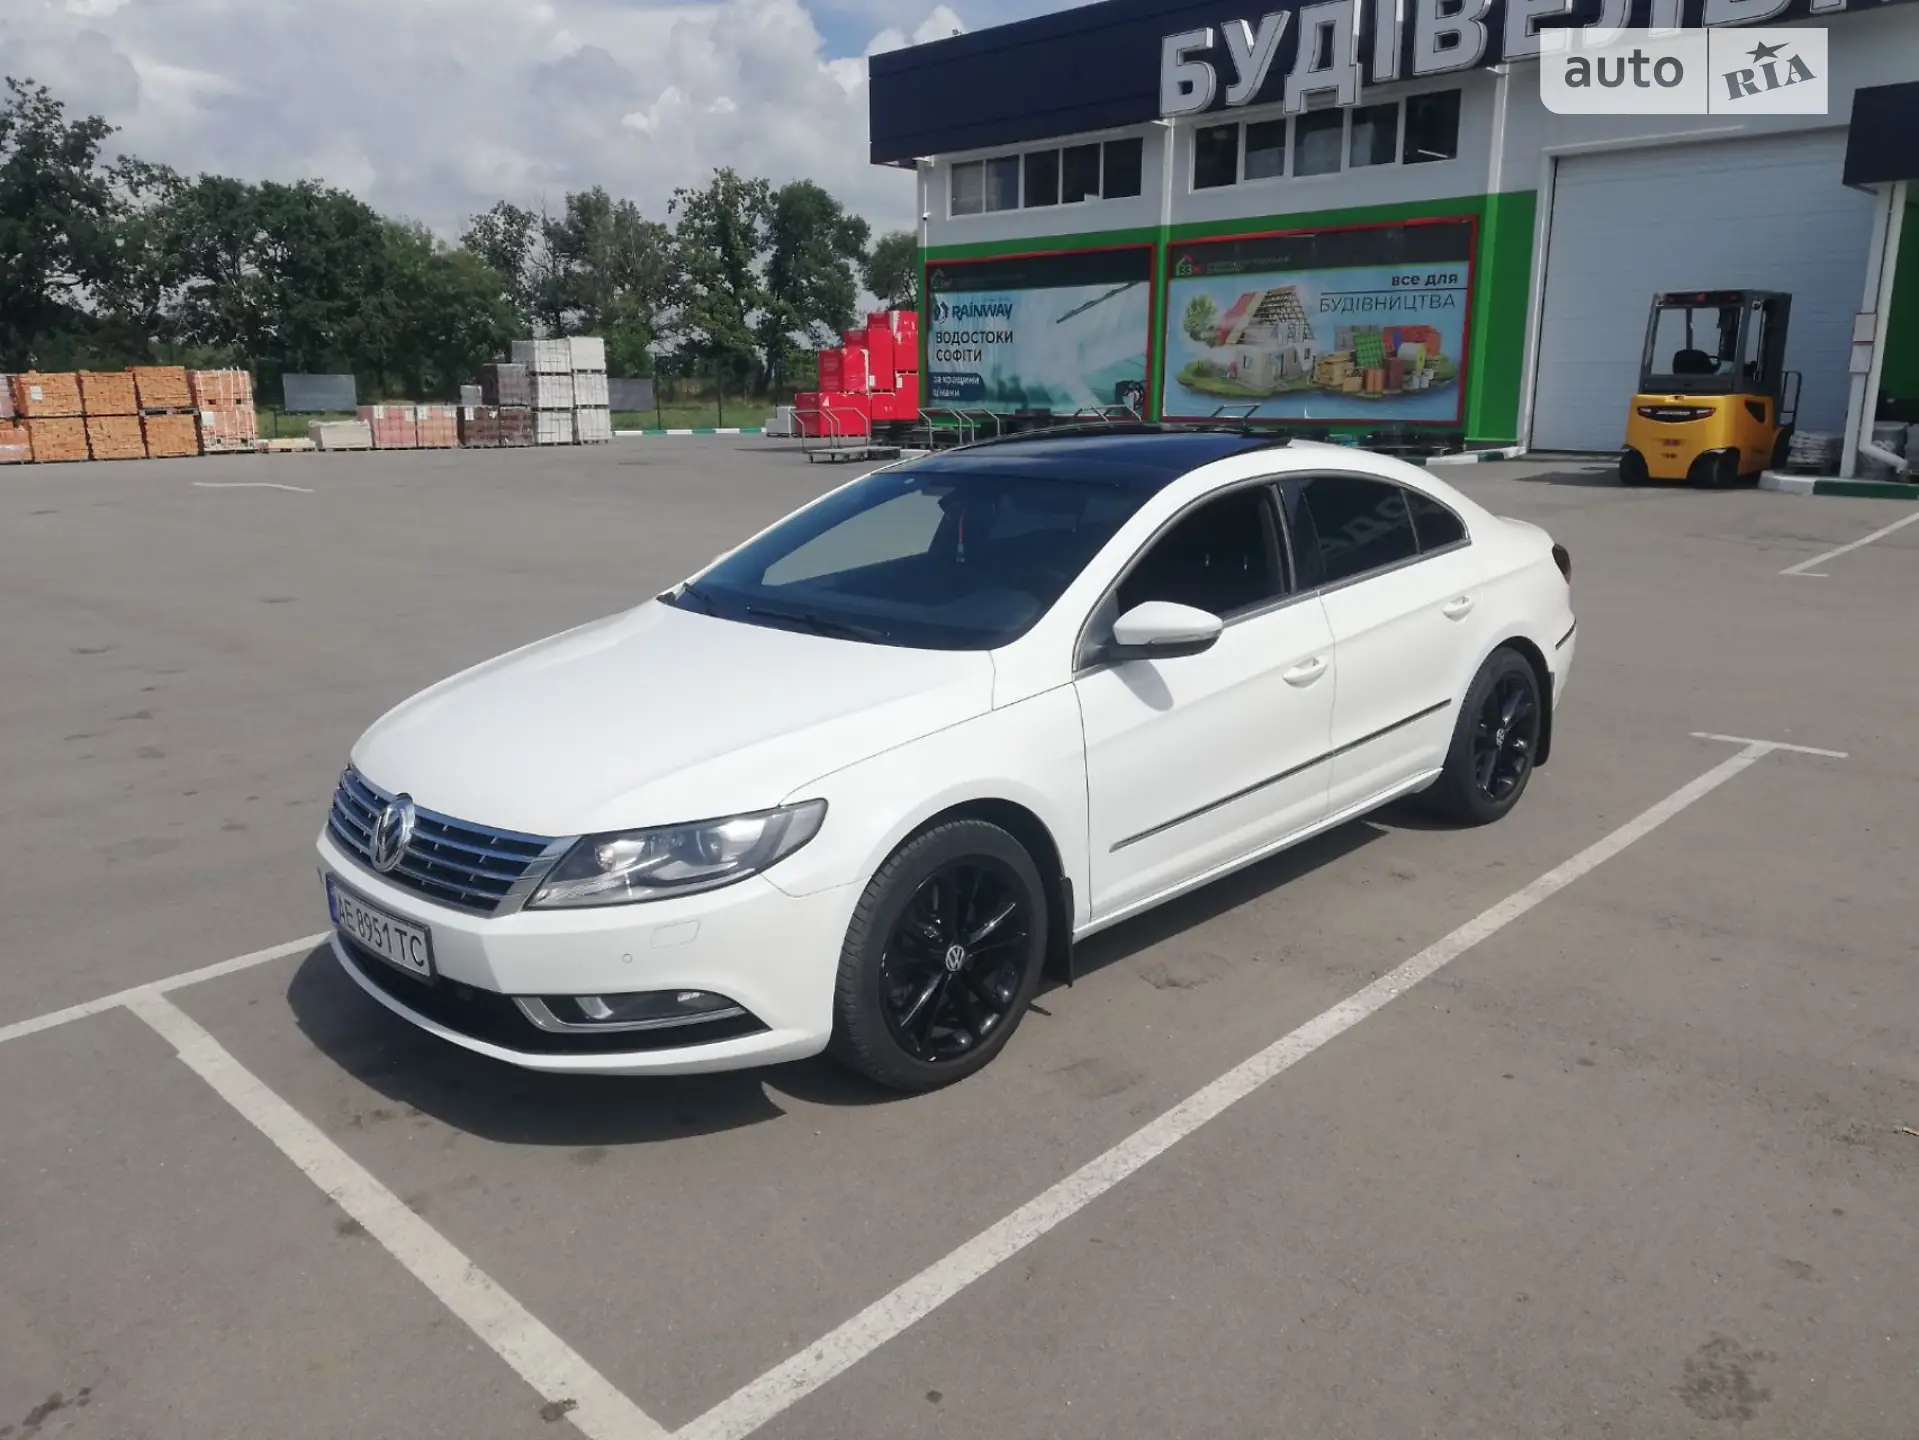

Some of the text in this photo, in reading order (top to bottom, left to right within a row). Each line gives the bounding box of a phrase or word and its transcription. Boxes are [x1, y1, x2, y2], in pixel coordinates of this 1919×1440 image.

[1391, 273, 1458, 287] все для
[1319, 294, 1456, 314] БУДІВНИЦТВА
[935, 331, 1013, 346] ВОДОСТОКИ
[936, 349, 982, 362] СОФІТИ
[356, 908, 392, 954] 8951
[394, 926, 425, 968] TC
